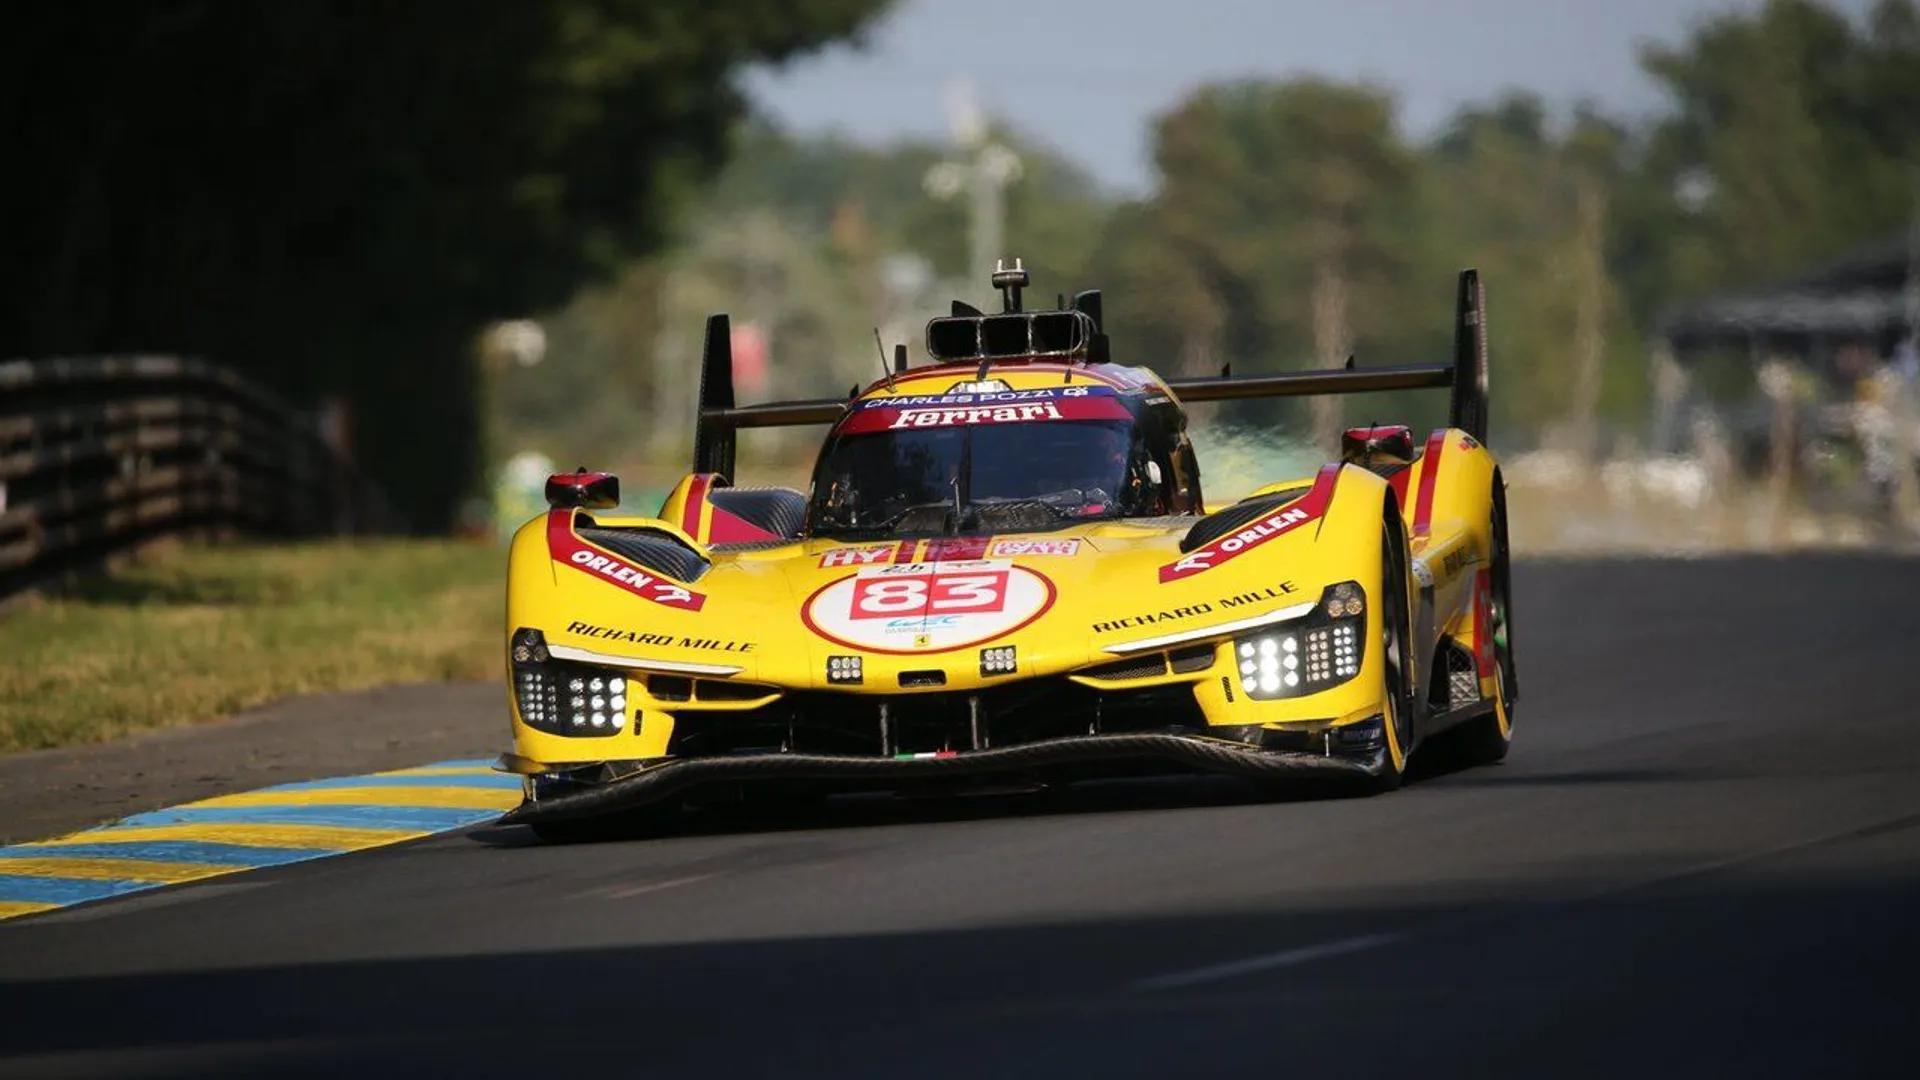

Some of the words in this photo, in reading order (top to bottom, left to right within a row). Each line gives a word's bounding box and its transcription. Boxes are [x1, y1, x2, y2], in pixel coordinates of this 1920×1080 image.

[864, 395, 974, 408] CHARLES
[980, 390, 1055, 402] POZZI
[888, 402, 1063, 429] Ferrari
[1220, 508, 1309, 552] ORLEN
[571, 550, 653, 588] ORLEN
[822, 547, 889, 567] HY
[860, 575, 998, 613] 83
[1092, 602, 1212, 633] RICHARD
[1219, 580, 1299, 608] MILLE
[567, 621, 674, 646] RICHARD
[678, 637, 757, 653] MILLE
